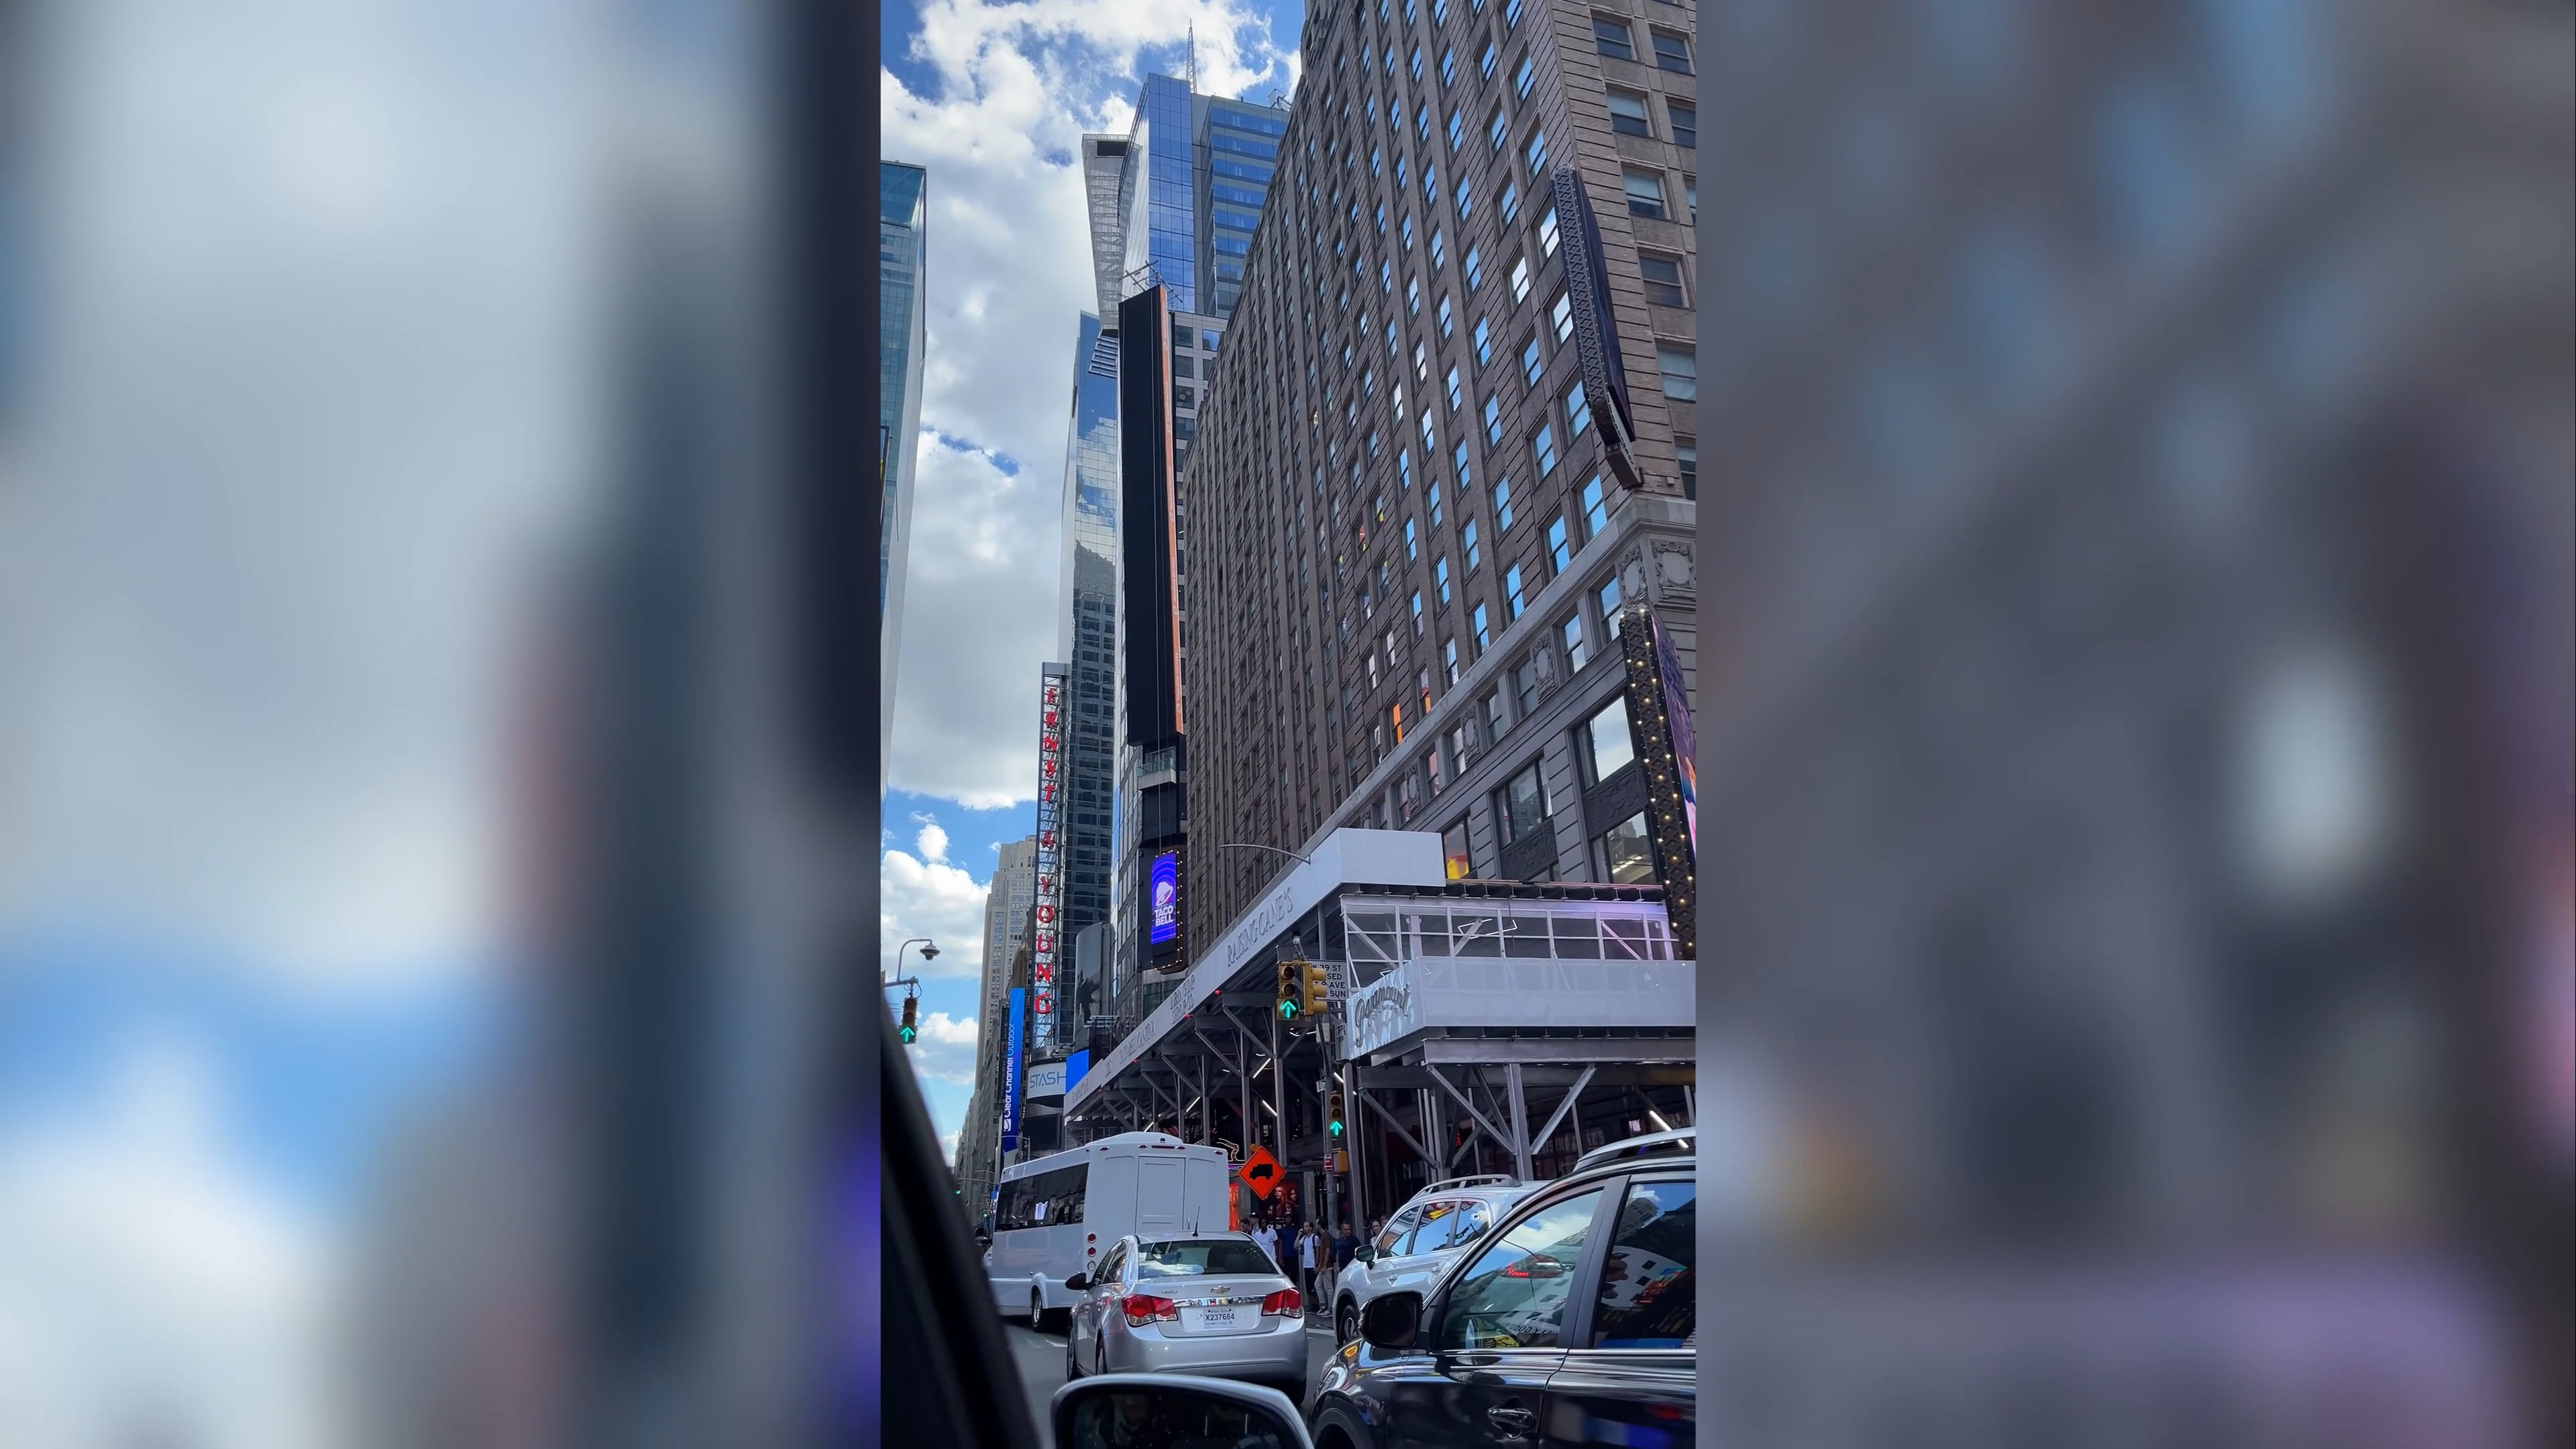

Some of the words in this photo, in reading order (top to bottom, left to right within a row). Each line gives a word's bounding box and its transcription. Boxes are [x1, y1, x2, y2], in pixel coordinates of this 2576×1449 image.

[1042, 688, 1059, 803] ERNST
[1041, 830, 1055, 849] &
[1154, 905, 1173, 918] TACO
[1155, 915, 1174, 927] BELL
[1227, 919, 1258, 967] RAISING
[1258, 886, 1293, 936] CANE'S
[1034, 874, 1055, 1015] YOUNG
[1355, 982, 1411, 1048] Paramount
[1007, 1024, 1015, 1057] Outdoor
[1005, 1057, 1014, 1093] Channel
[1004, 1093, 1012, 1118] Clear
[1205, 1313, 1235, 1321] X237684
